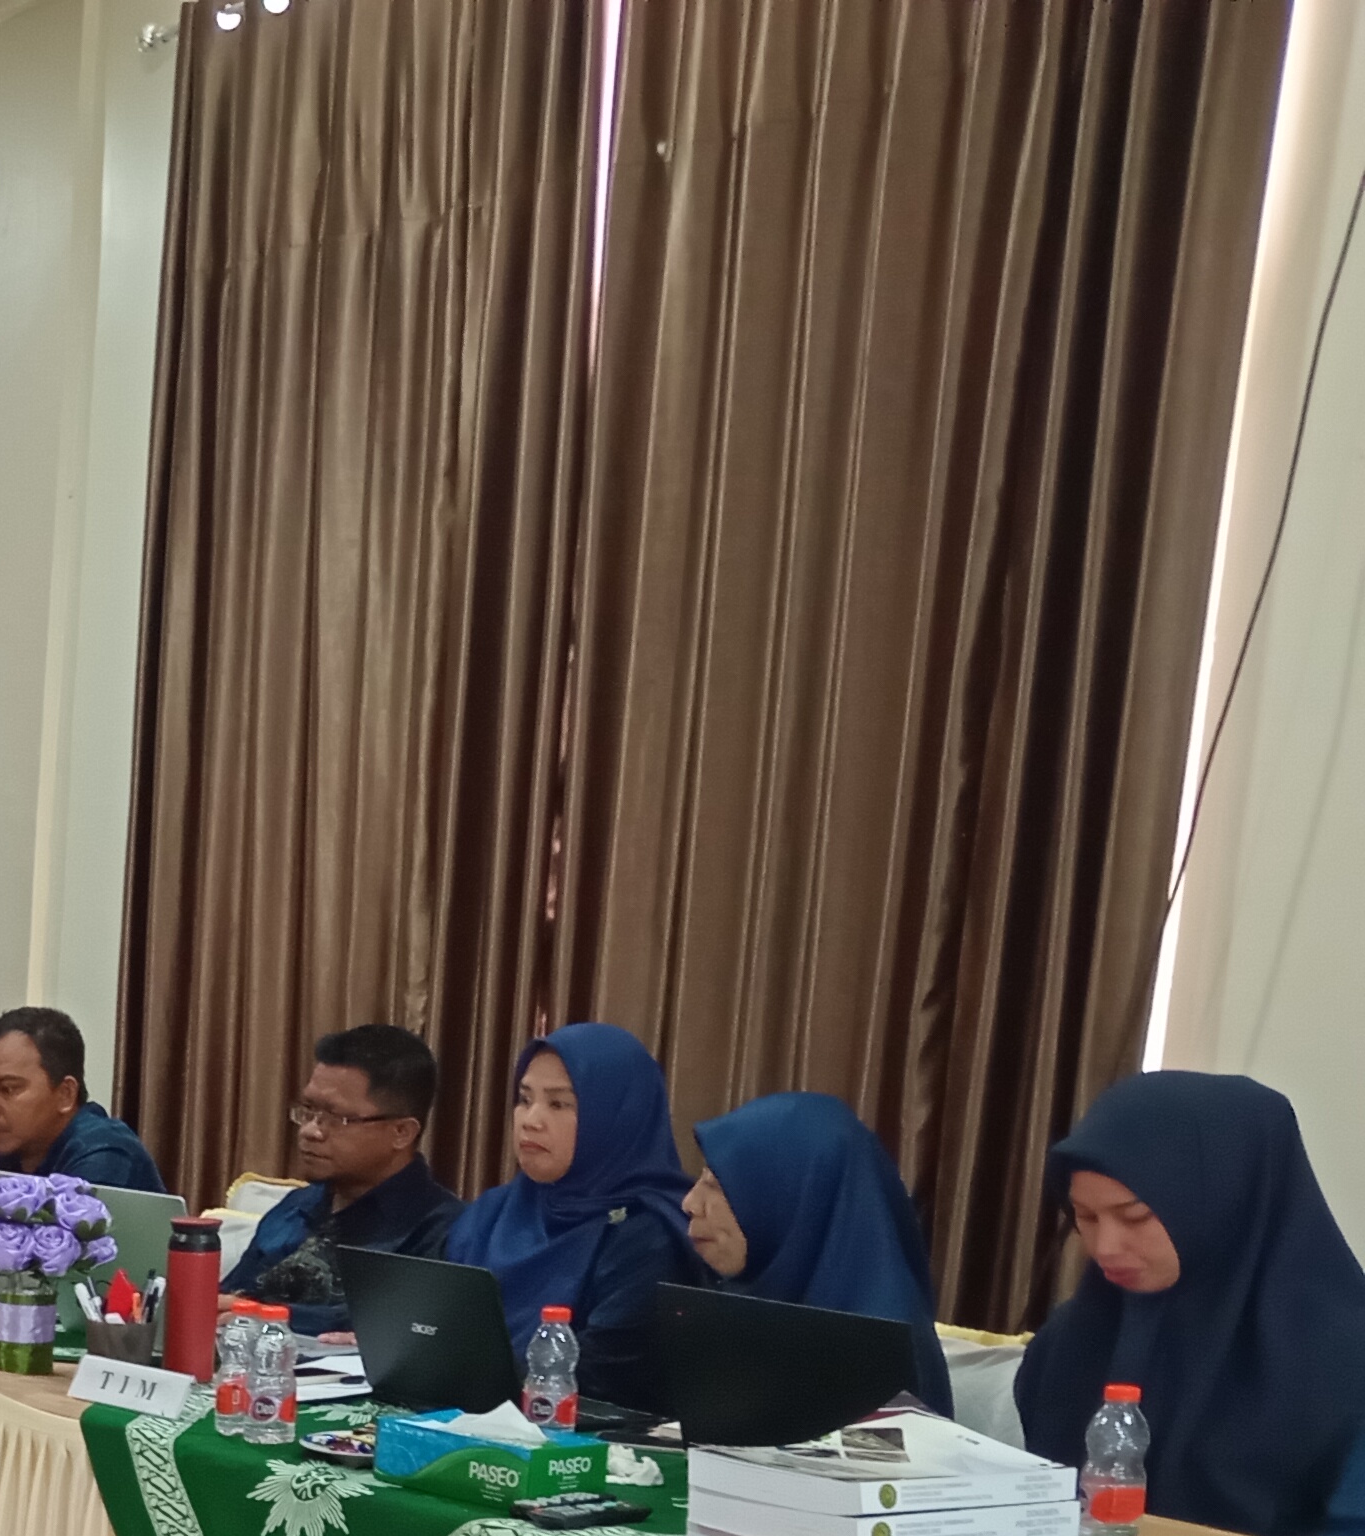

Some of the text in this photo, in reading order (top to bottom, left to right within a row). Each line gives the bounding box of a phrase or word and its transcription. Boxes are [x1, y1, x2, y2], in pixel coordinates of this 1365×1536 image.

[411, 1322, 439, 1336] acer
[468, 1460, 521, 1489] PASEO
[547, 1455, 593, 1477] PASEO
